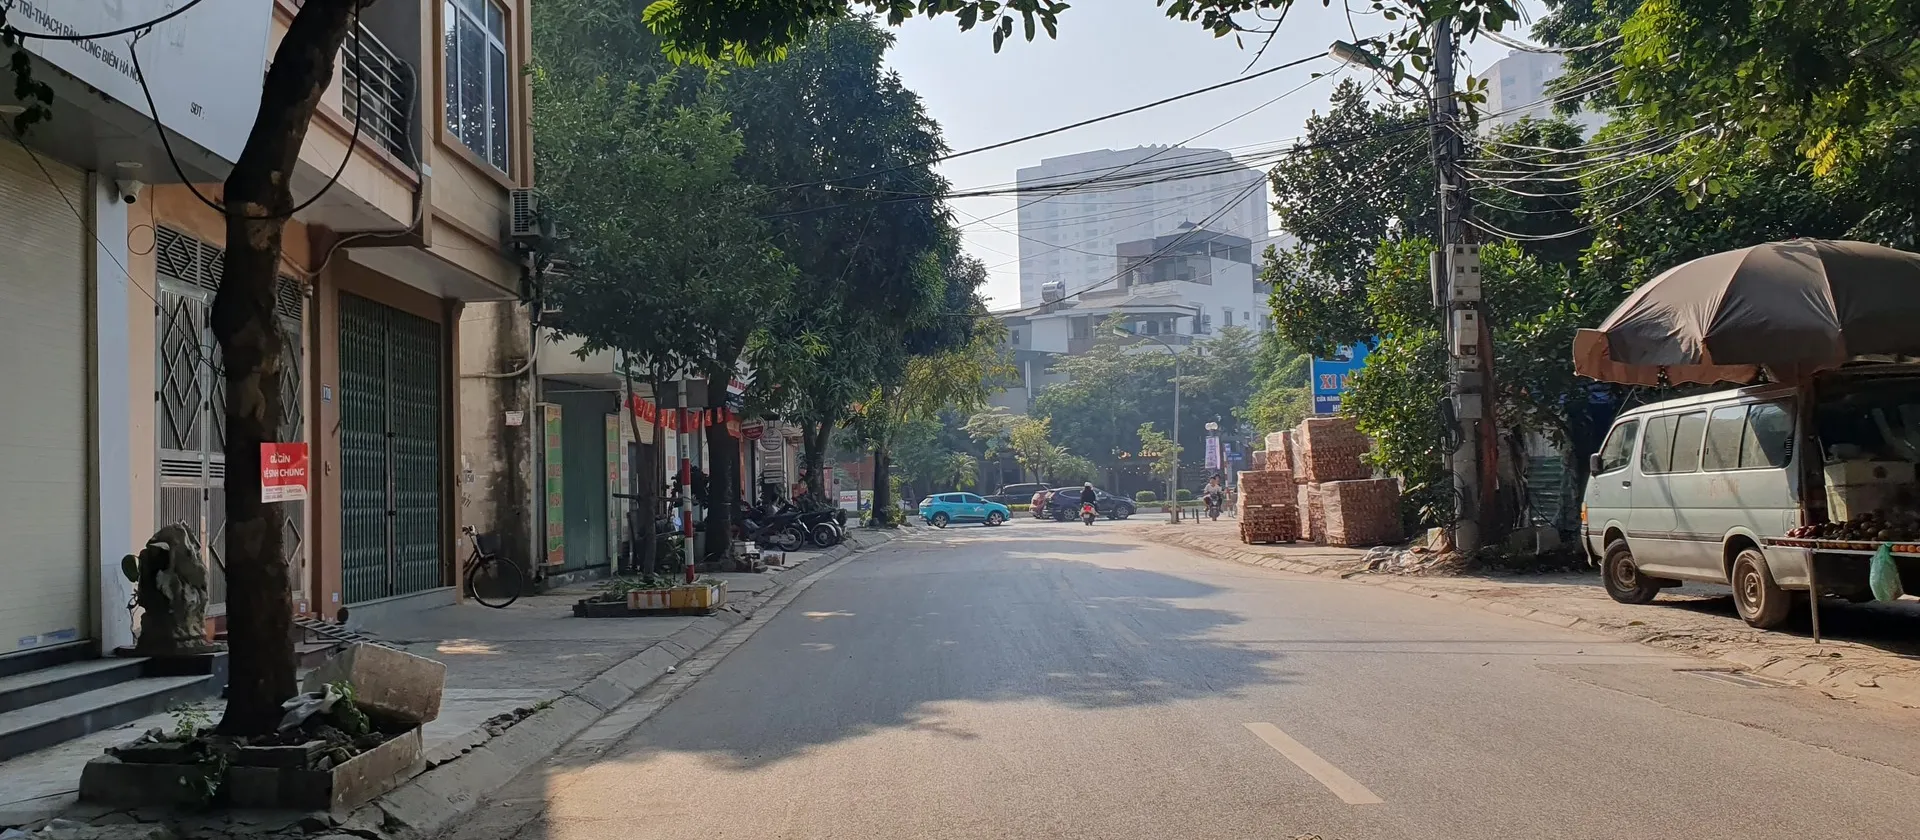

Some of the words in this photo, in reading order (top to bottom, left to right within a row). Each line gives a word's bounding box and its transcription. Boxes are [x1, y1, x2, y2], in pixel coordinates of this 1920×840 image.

[102, 49, 120, 70] BIÊN
[1320, 373, 1338, 389] XI
[279, 467, 305, 477] CHUNG
